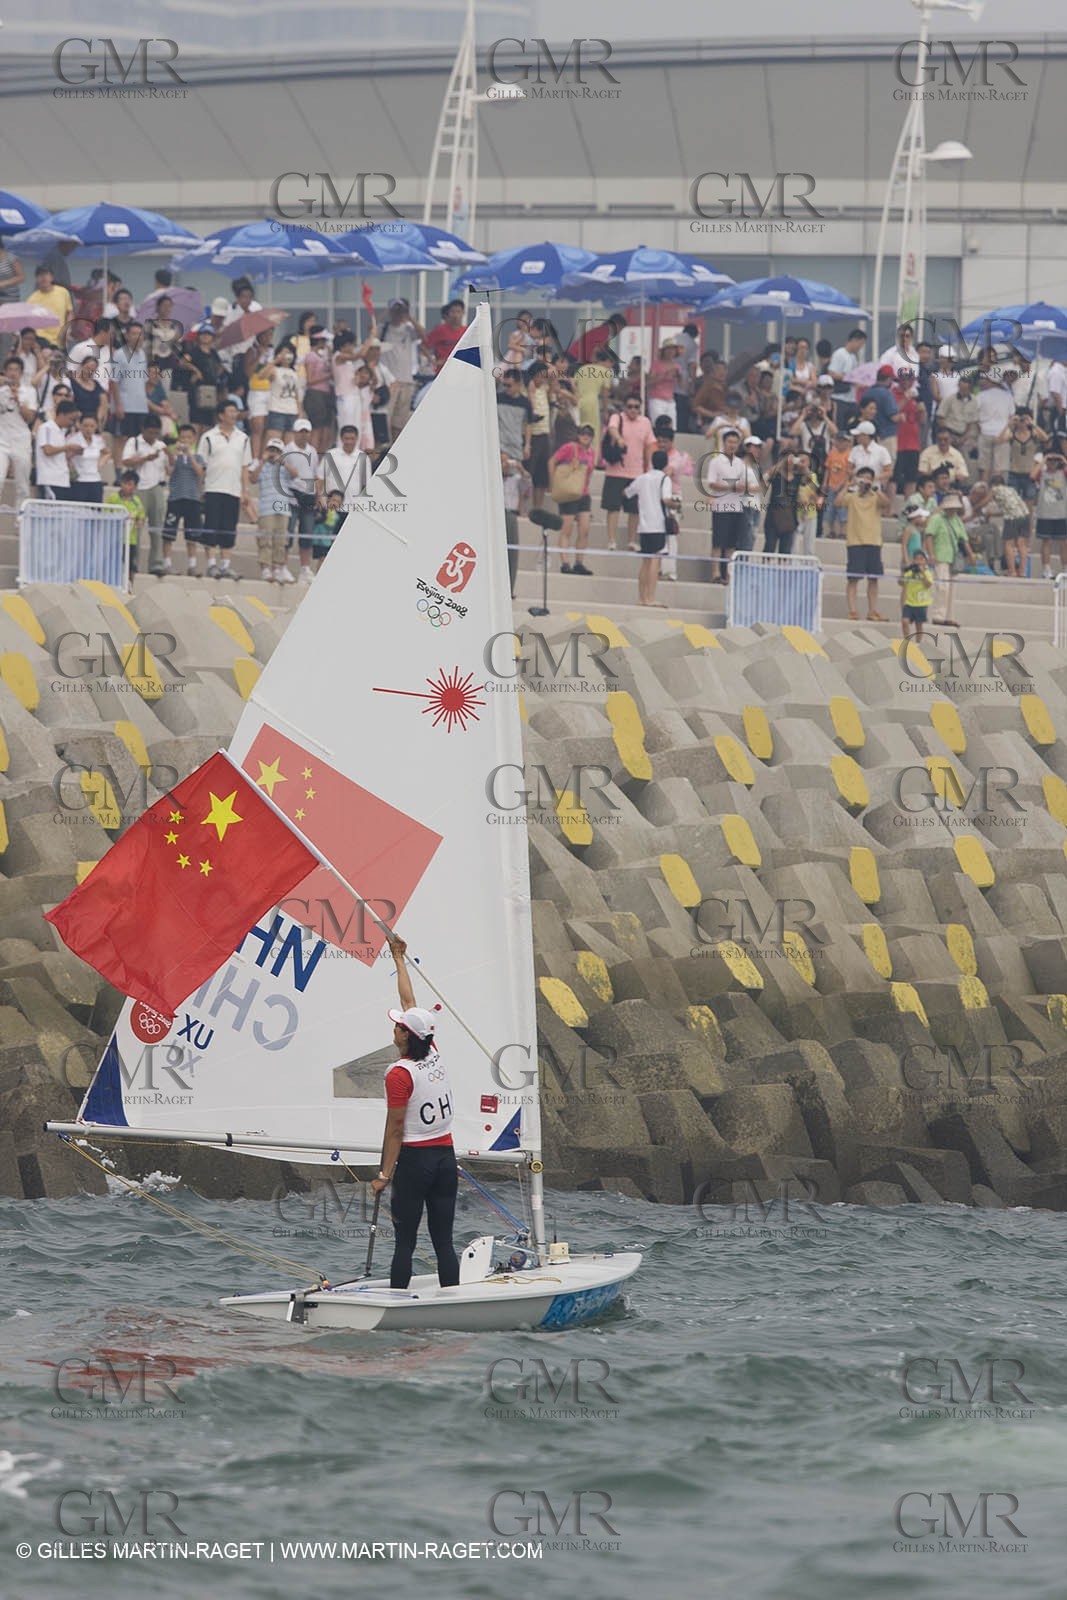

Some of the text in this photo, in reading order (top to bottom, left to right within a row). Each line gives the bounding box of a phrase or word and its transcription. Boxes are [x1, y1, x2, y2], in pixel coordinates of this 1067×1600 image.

[235, 914, 327, 993] HN
[176, 1013, 214, 1050] XU
[420, 1090, 453, 1125] CH
